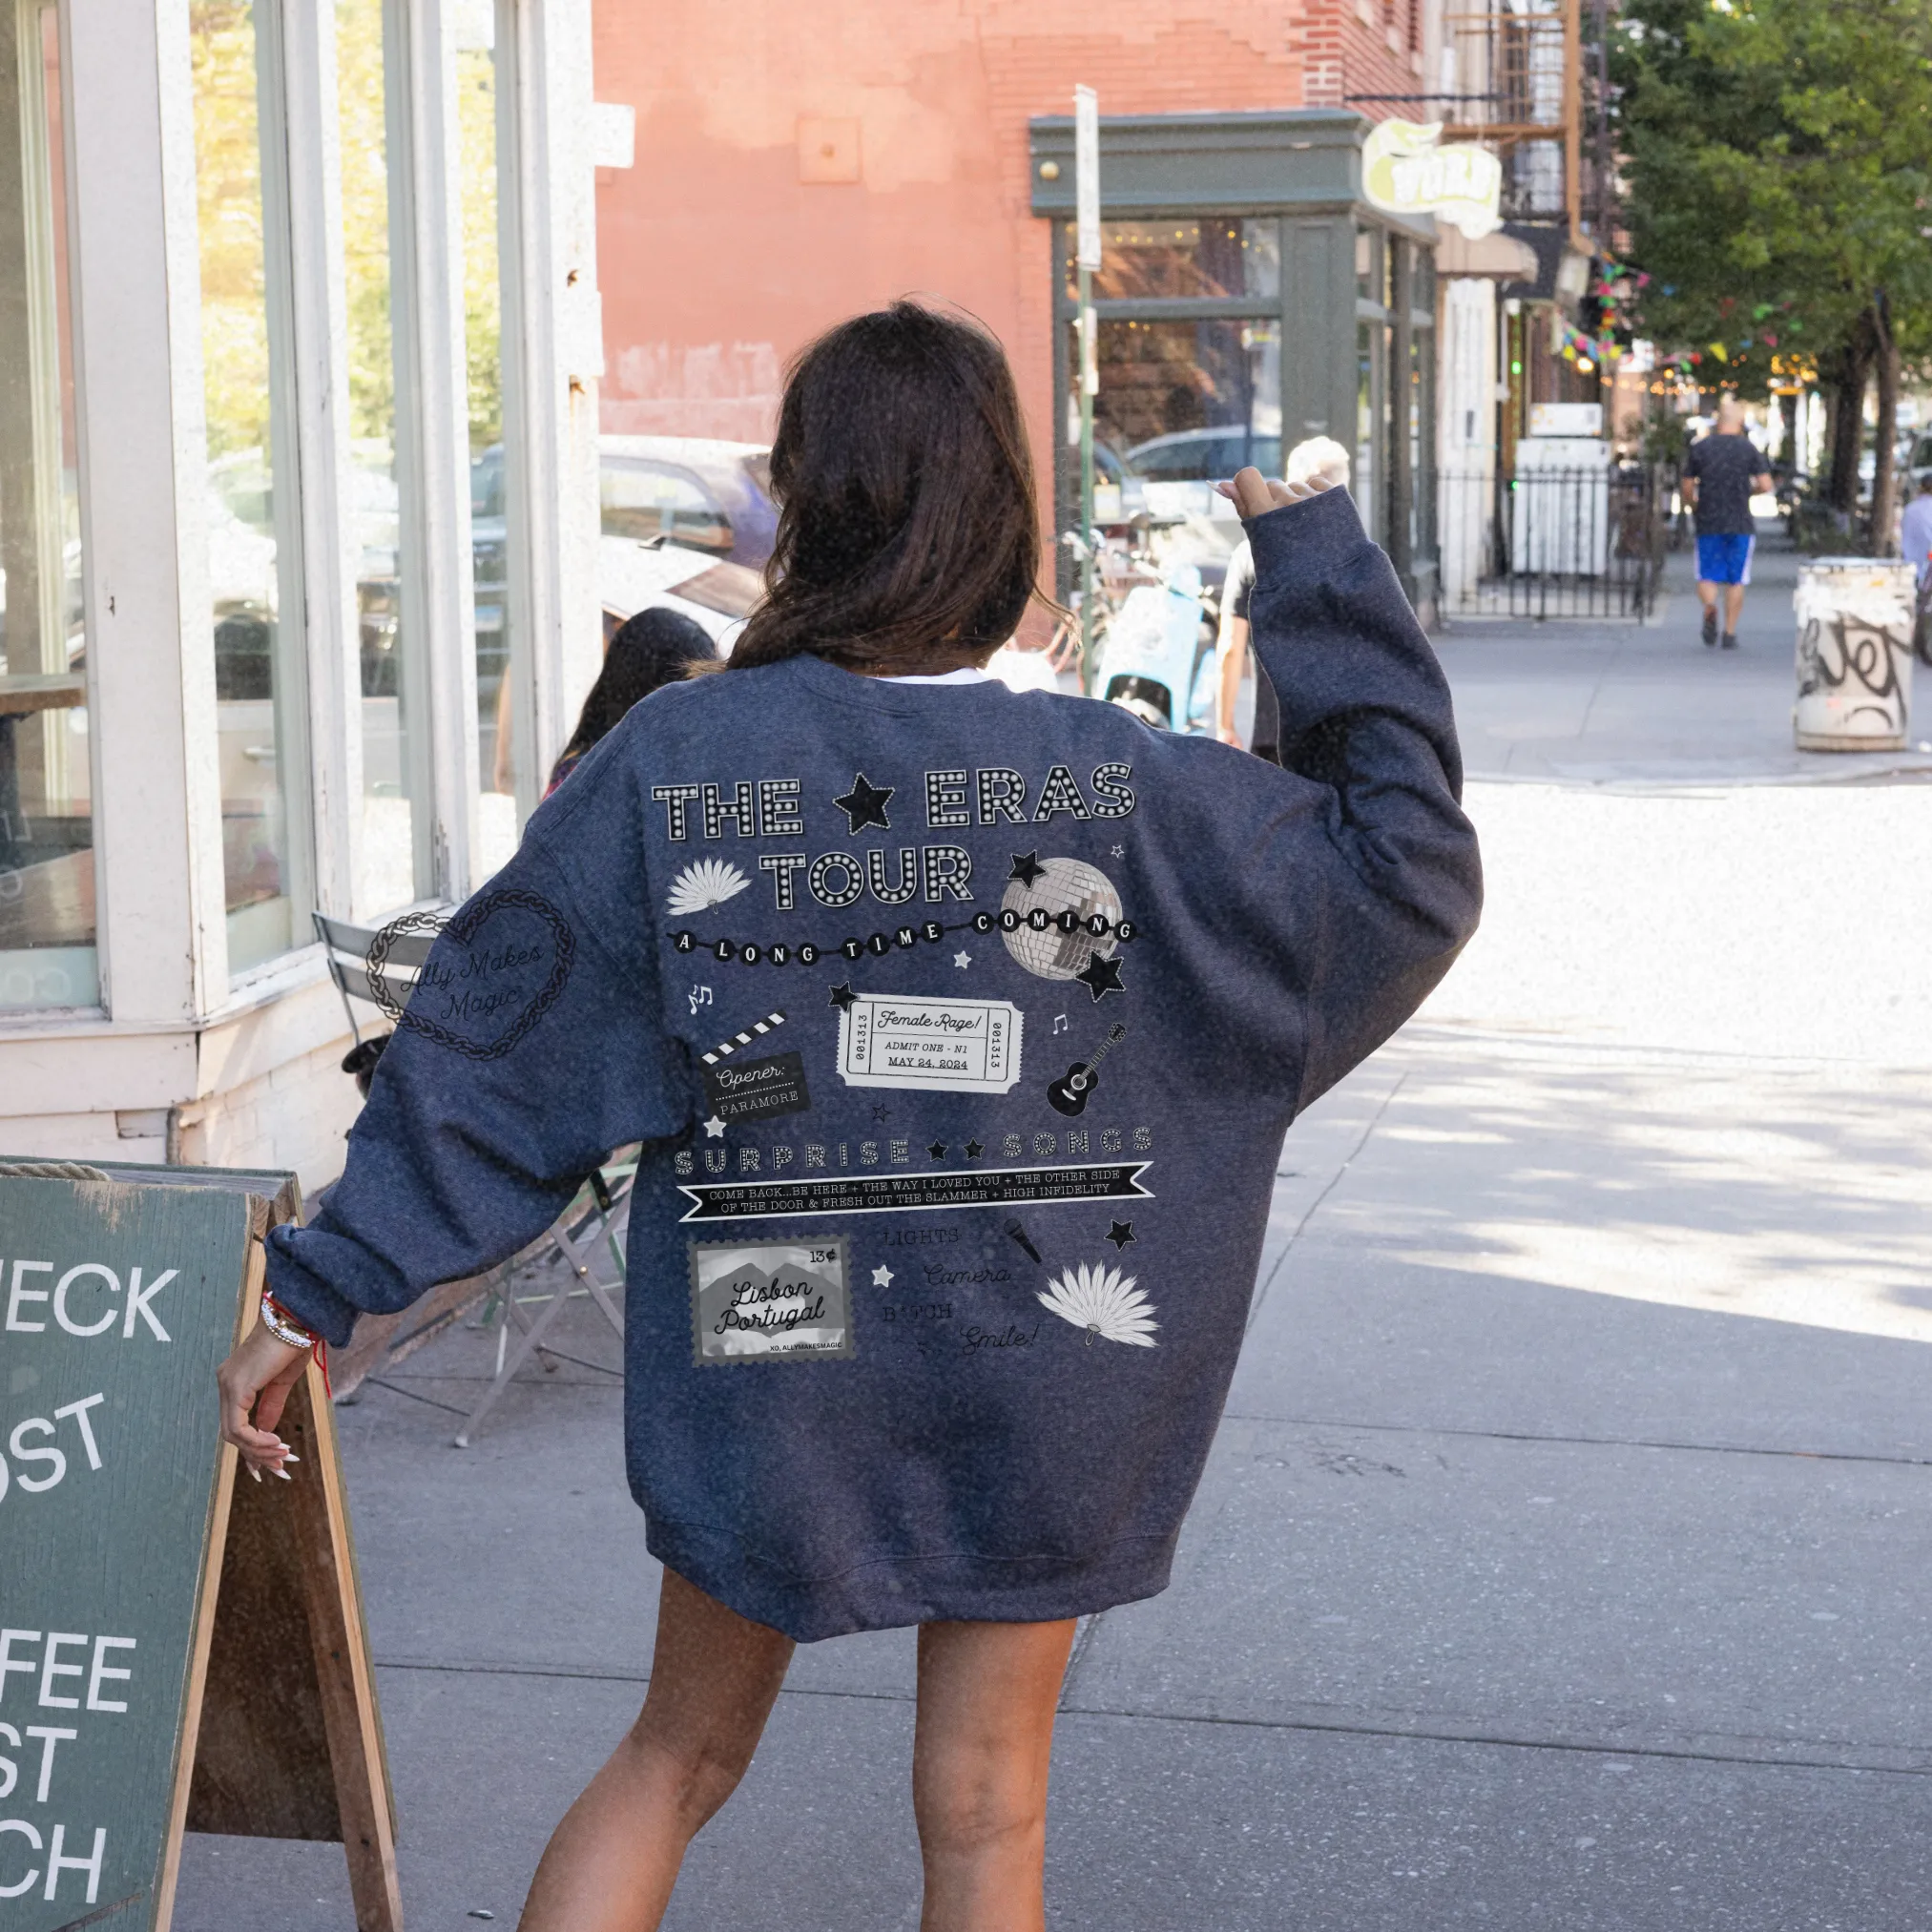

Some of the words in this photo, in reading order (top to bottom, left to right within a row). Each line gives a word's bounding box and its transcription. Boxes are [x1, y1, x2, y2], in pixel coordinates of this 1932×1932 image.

[651, 779, 803, 841] THE
[924, 762, 1135, 827] ERAS
[758, 844, 974, 910] TOUR
[847, 924, 938, 957] TIME
[978, 912, 1131, 937] COMING
[877, 1010, 933, 1028] Female
[934, 1013, 982, 1032] Rage!
[856, 1014, 867, 1060] 001313
[884, 1042, 920, 1051] ADMIT
[922, 1043, 945, 1052] ONE
[954, 1045, 967, 1053] N1
[990, 1023, 1002, 1068] 001313
[717, 1066, 784, 1090] Opener:
[888, 1056, 915, 1067] MAY
[918, 1059, 935, 1069] 24,
[939, 1059, 968, 1070] 2024
[720, 1091, 799, 1115] PARAMORE
[675, 1139, 909, 1175] SURPRISE
[1003, 1127, 1152, 1157] SONGS
[709, 1189, 744, 1200] COME
[813, 1184, 847, 1195] HERE
[862, 1181, 888, 1193] THE
[892, 1180, 918, 1191] WAY
[931, 1177, 972, 1189] LOVED
[975, 1175, 1001, 1187] YOU
[1016, 1174, 1041, 1185] THE
[1045, 1172, 1087, 1183] OTHER
[1091, 1170, 1120, 1180] SIDE
[720, 1202, 737, 1214] OF
[741, 1201, 766, 1212] THE
[770, 1199, 804, 1211] DOOR
[808, 1198, 819, 1209] &
[822, 1196, 863, 1208] FRESH
[867, 1195, 892, 1205] OUT
[896, 1194, 922, 1204] THE
[925, 1190, 988, 1202] SLAMMER
[1003, 1187, 1035, 1198] HIGH
[1039, 1183, 1111, 1196] INFIDELITY
[883, 1228, 960, 1246] LIGHTS
[924, 1263, 1011, 1286] Camera
[0, 1258, 180, 1341] ECK
[730, 1278, 813, 1307] Lisbon
[714, 1296, 825, 1335] Portugal
[782, 1342, 842, 1351] ALLYMAKESMAGIC
[959, 1323, 1040, 1356] Smile!
[0, 1392, 104, 1503] ST
